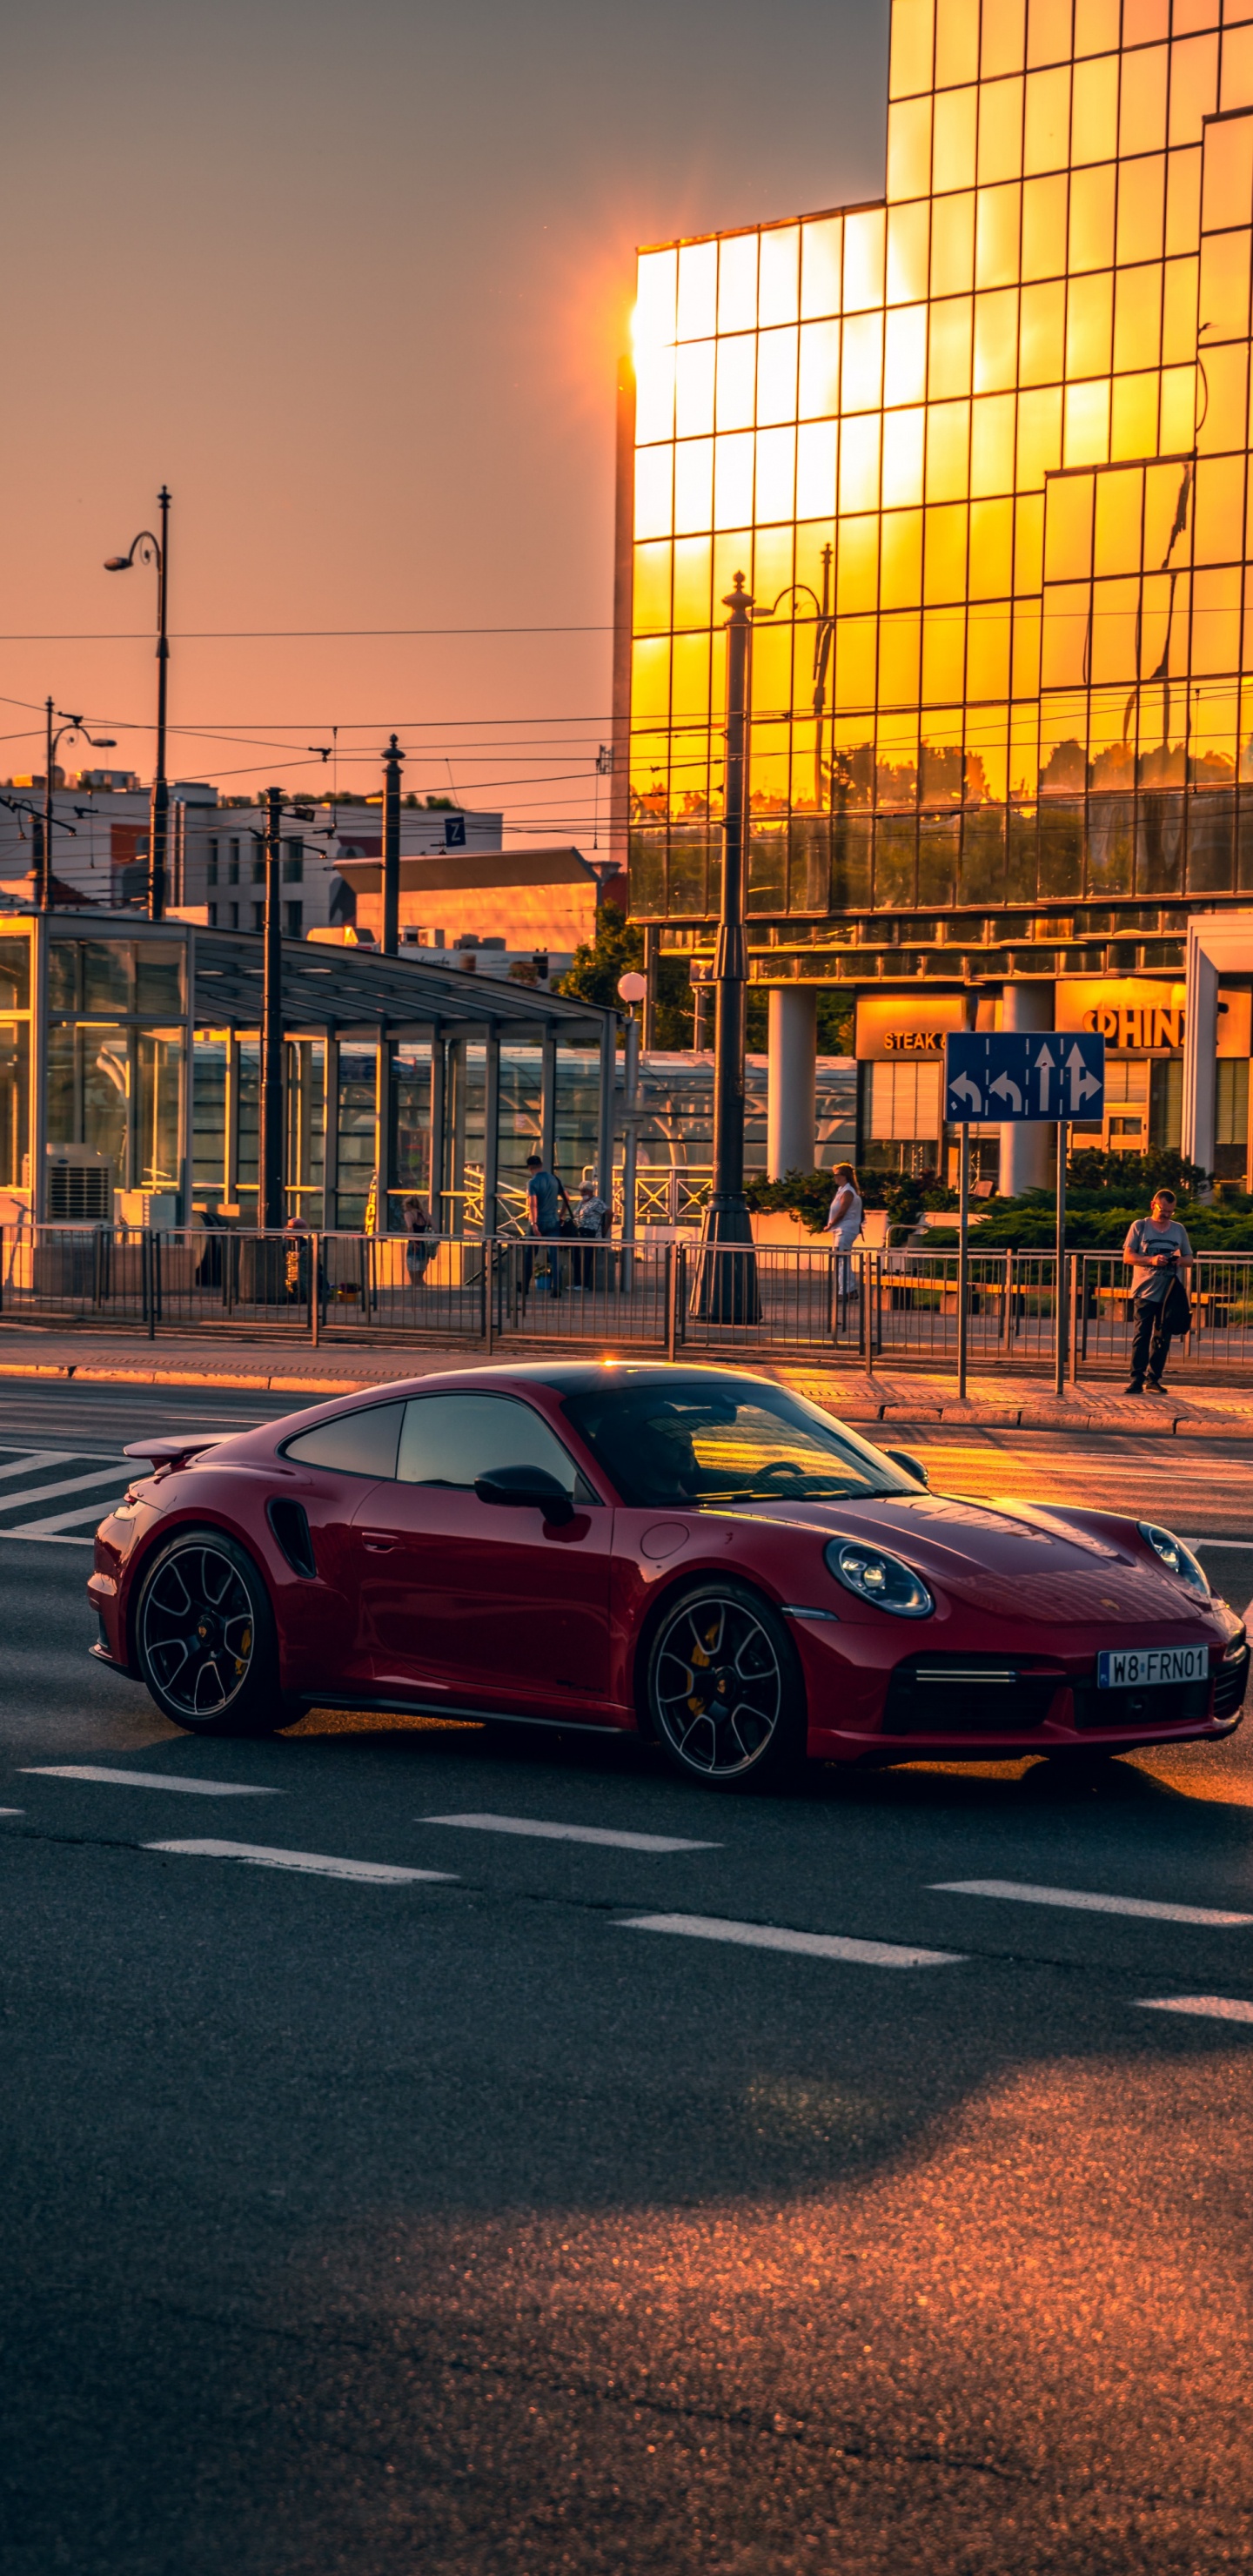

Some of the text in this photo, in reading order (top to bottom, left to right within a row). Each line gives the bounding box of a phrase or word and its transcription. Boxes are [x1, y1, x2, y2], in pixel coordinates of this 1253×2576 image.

[451, 823, 460, 842] Z
[884, 1032, 937, 1050] STEAK
[1083, 1010, 1186, 1048] SPHIN
[1114, 1650, 1203, 1682] W8 FRN01
